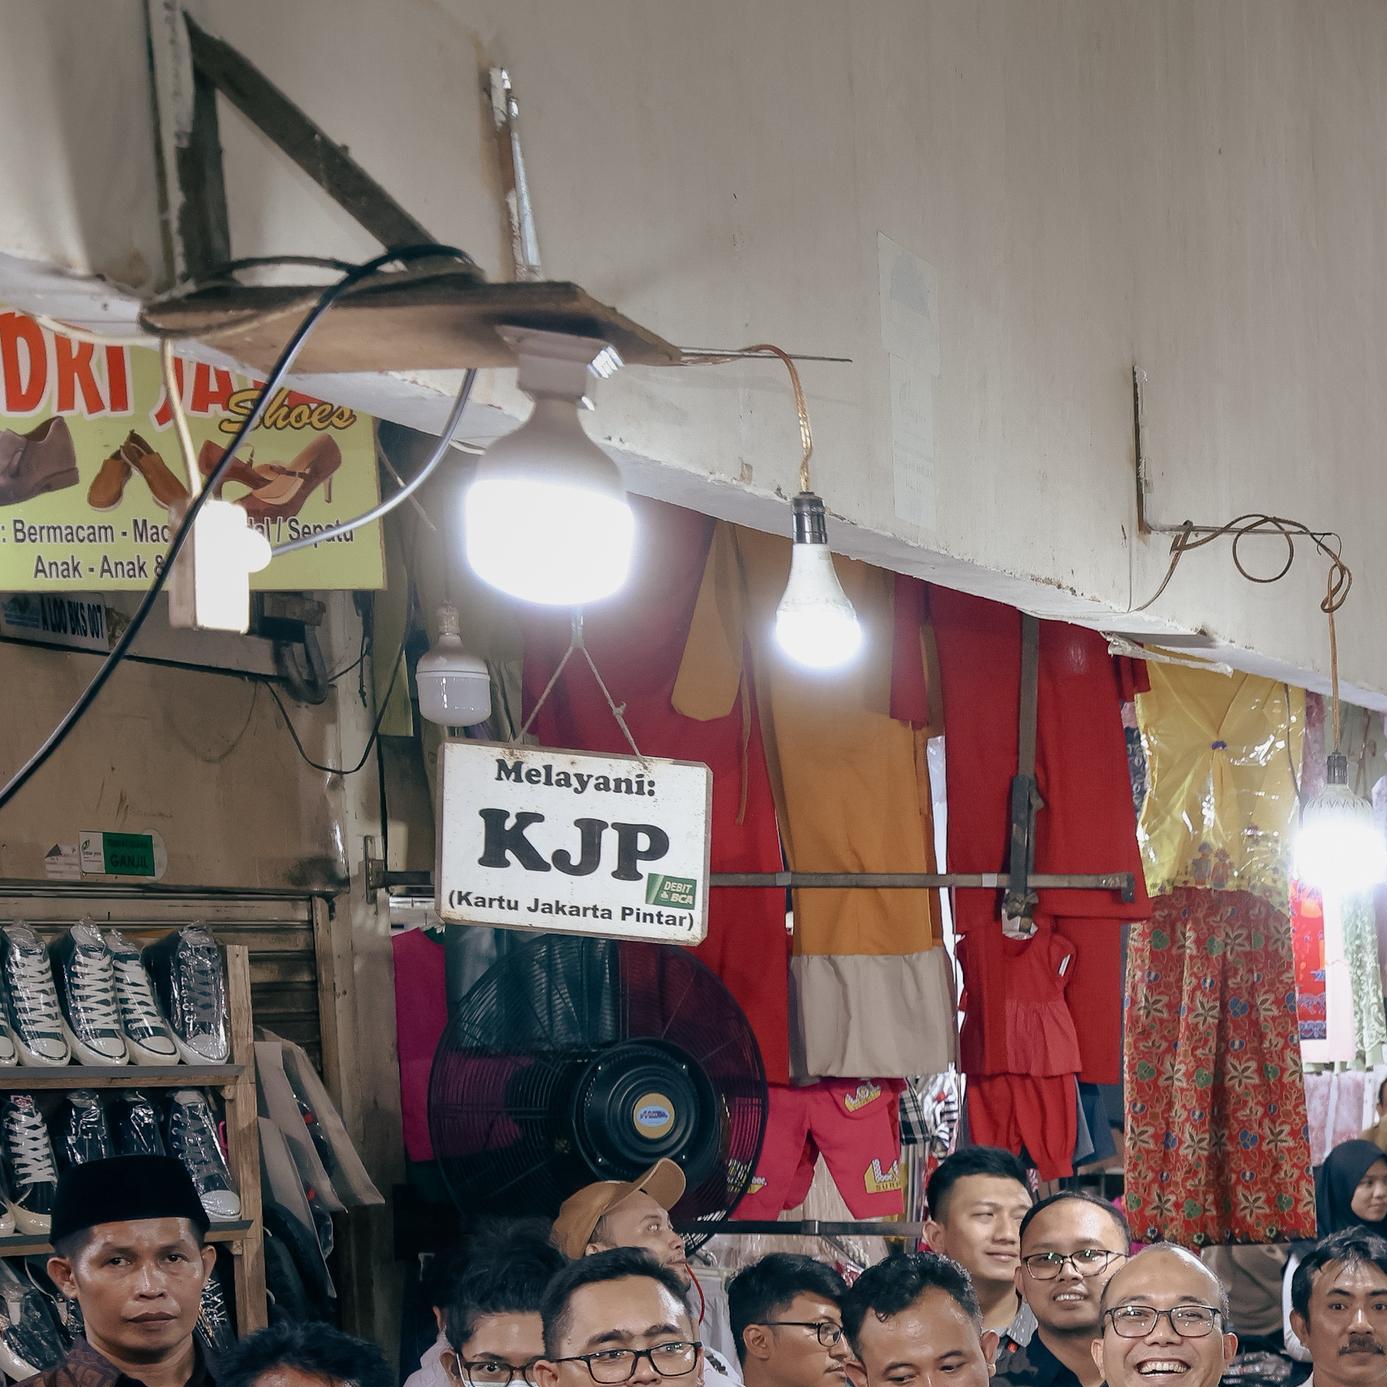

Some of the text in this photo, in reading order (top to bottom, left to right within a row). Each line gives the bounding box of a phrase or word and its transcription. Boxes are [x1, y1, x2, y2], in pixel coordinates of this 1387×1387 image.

[219, 386, 356, 433] Shoes
[13, 519, 115, 543] Bermacam
[287, 516, 354, 549] Sepatu
[34, 555, 83, 579] Anak
[100, 555, 149, 579] Anak
[495, 758, 656, 797] Melayani:
[478, 808, 670, 881] KJP
[110, 854, 149, 869] GANJIL
[664, 881, 692, 894] DEBIT
[671, 893, 693, 905] BCA
[449, 890, 695, 931] (Kartu Jakarta Pintar)
